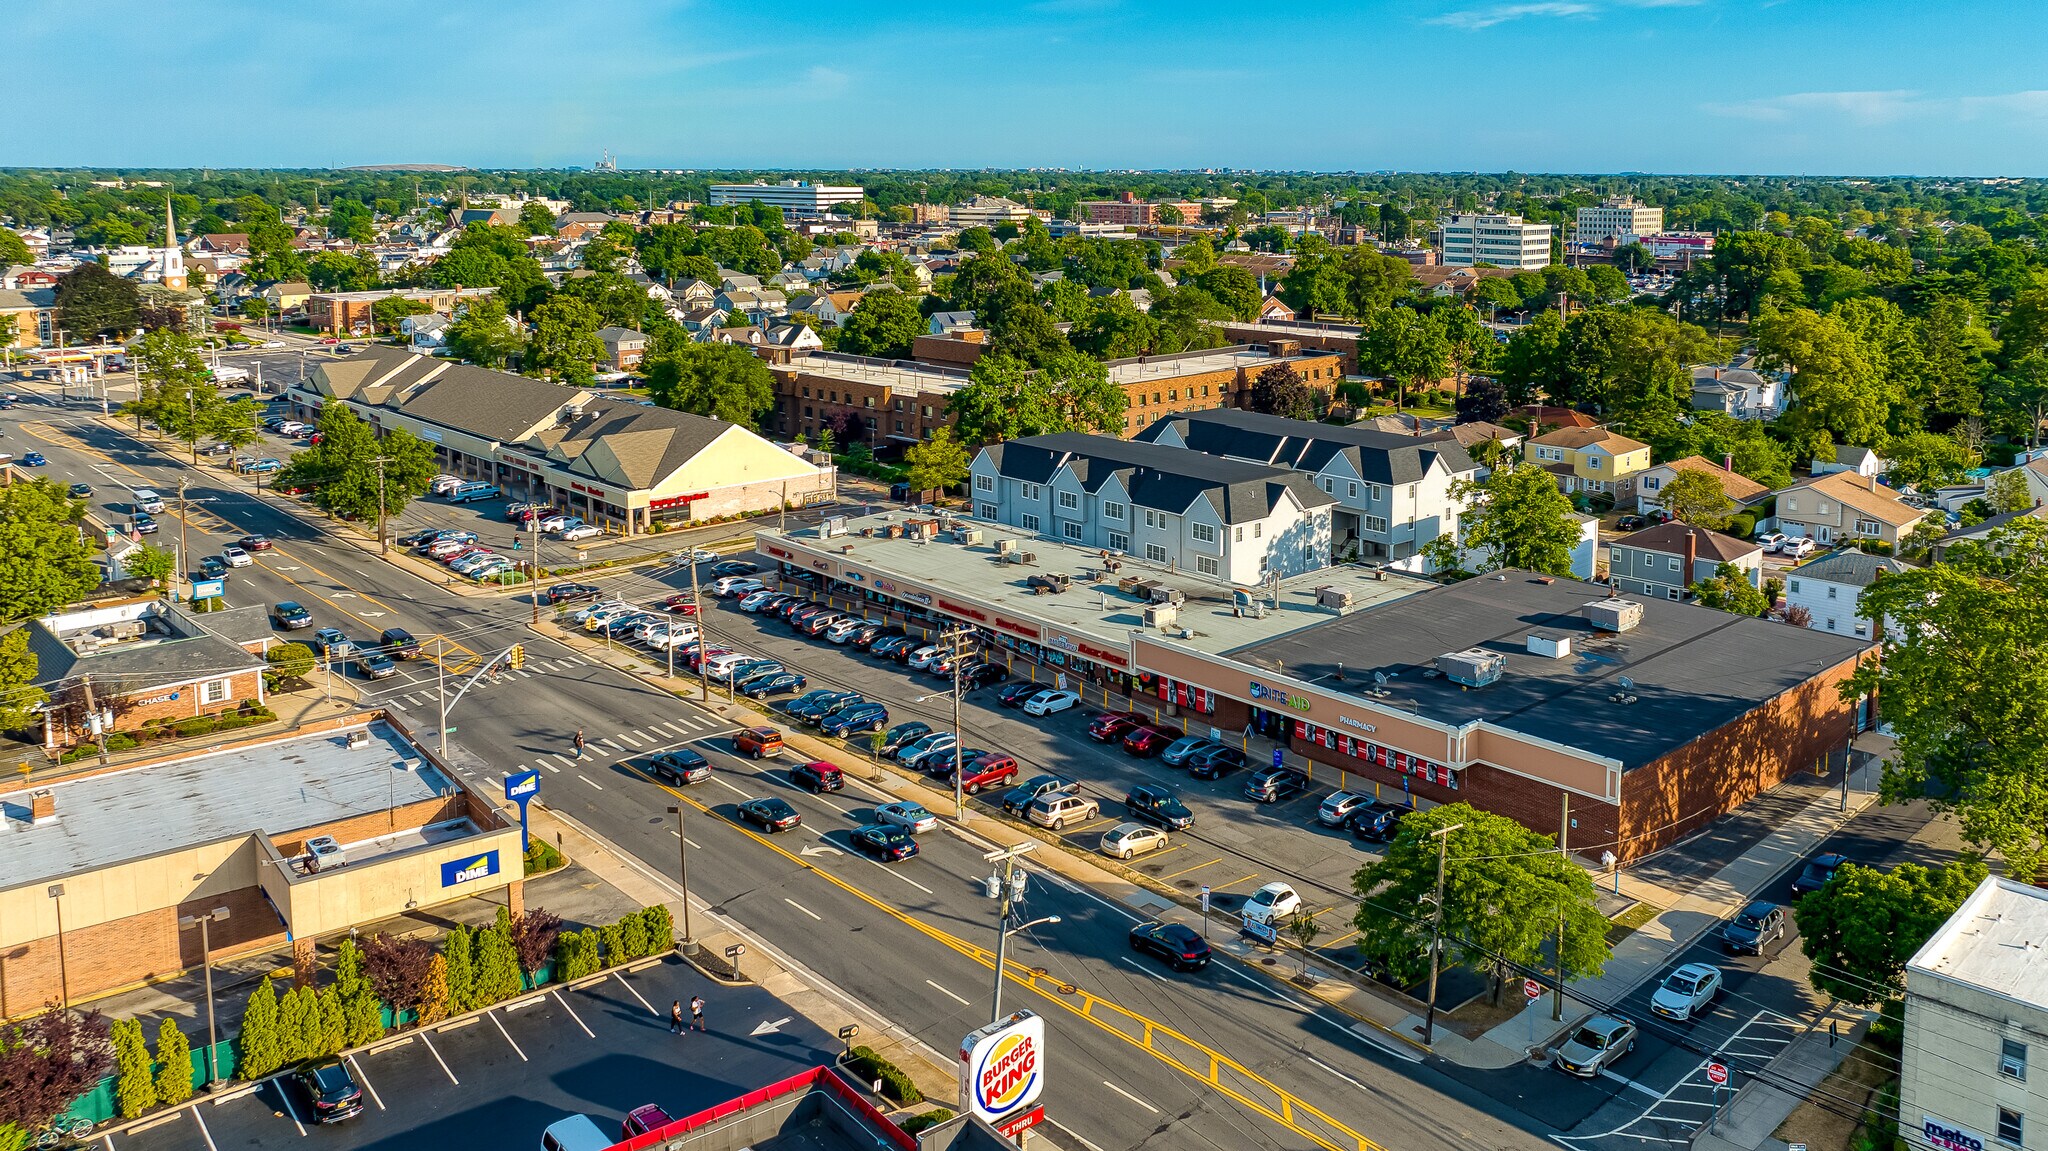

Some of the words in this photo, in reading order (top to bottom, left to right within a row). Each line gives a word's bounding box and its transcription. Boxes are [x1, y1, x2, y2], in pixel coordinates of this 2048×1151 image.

[138, 695, 171, 706] CHASE
[1261, 683, 1288, 705] RITE
[1288, 694, 1311, 712] AID
[1339, 715, 1377, 733] PHARMACY
[510, 782, 536, 796] DIME
[455, 865, 489, 883] DIME
[983, 1036, 1032, 1088] BURGER
[985, 1050, 1035, 1107] KING
[1011, 1115, 1033, 1133] THRU
[1924, 1121, 1983, 1150] metro
